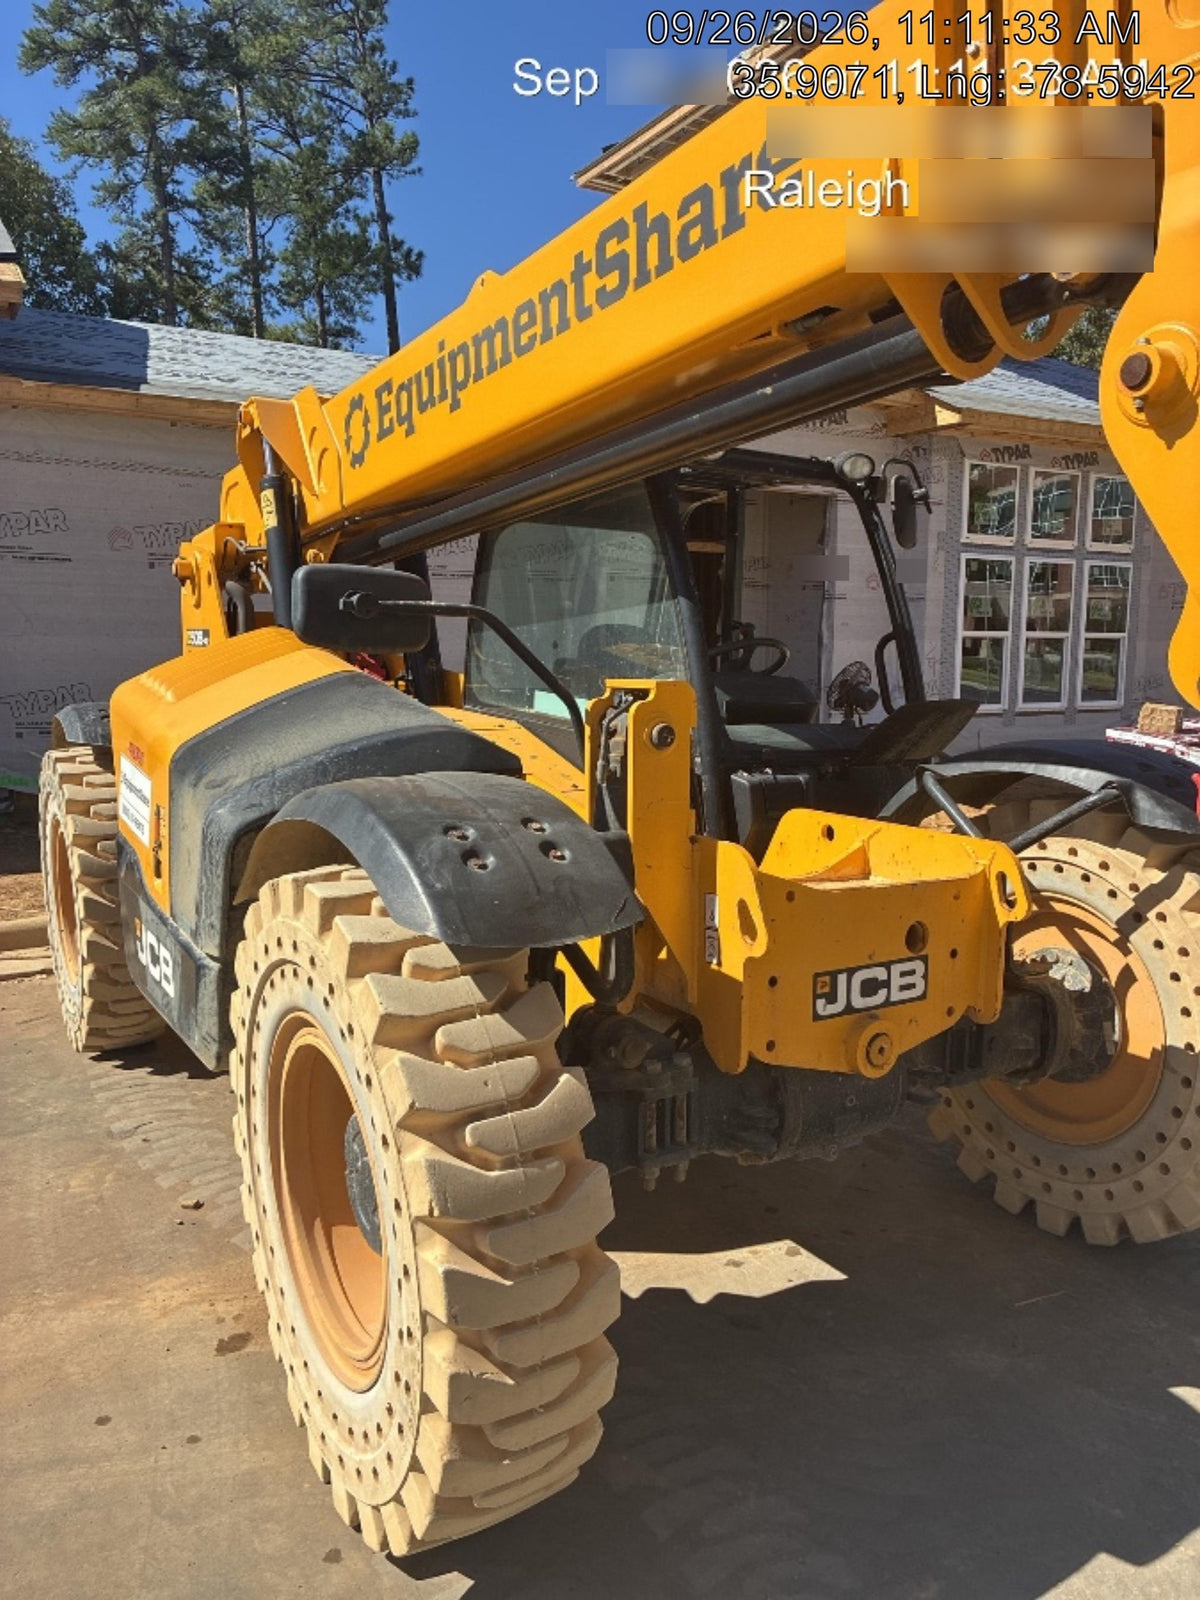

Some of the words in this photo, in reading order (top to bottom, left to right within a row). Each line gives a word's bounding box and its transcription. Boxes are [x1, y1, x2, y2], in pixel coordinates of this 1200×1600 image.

[991, 444, 1032, 463] TYPAR
[1061, 451, 1100, 470] TYPAR
[0, 507, 70, 539] YPAR
[136, 923, 175, 998] JCB
[815, 958, 926, 1017] JCB
